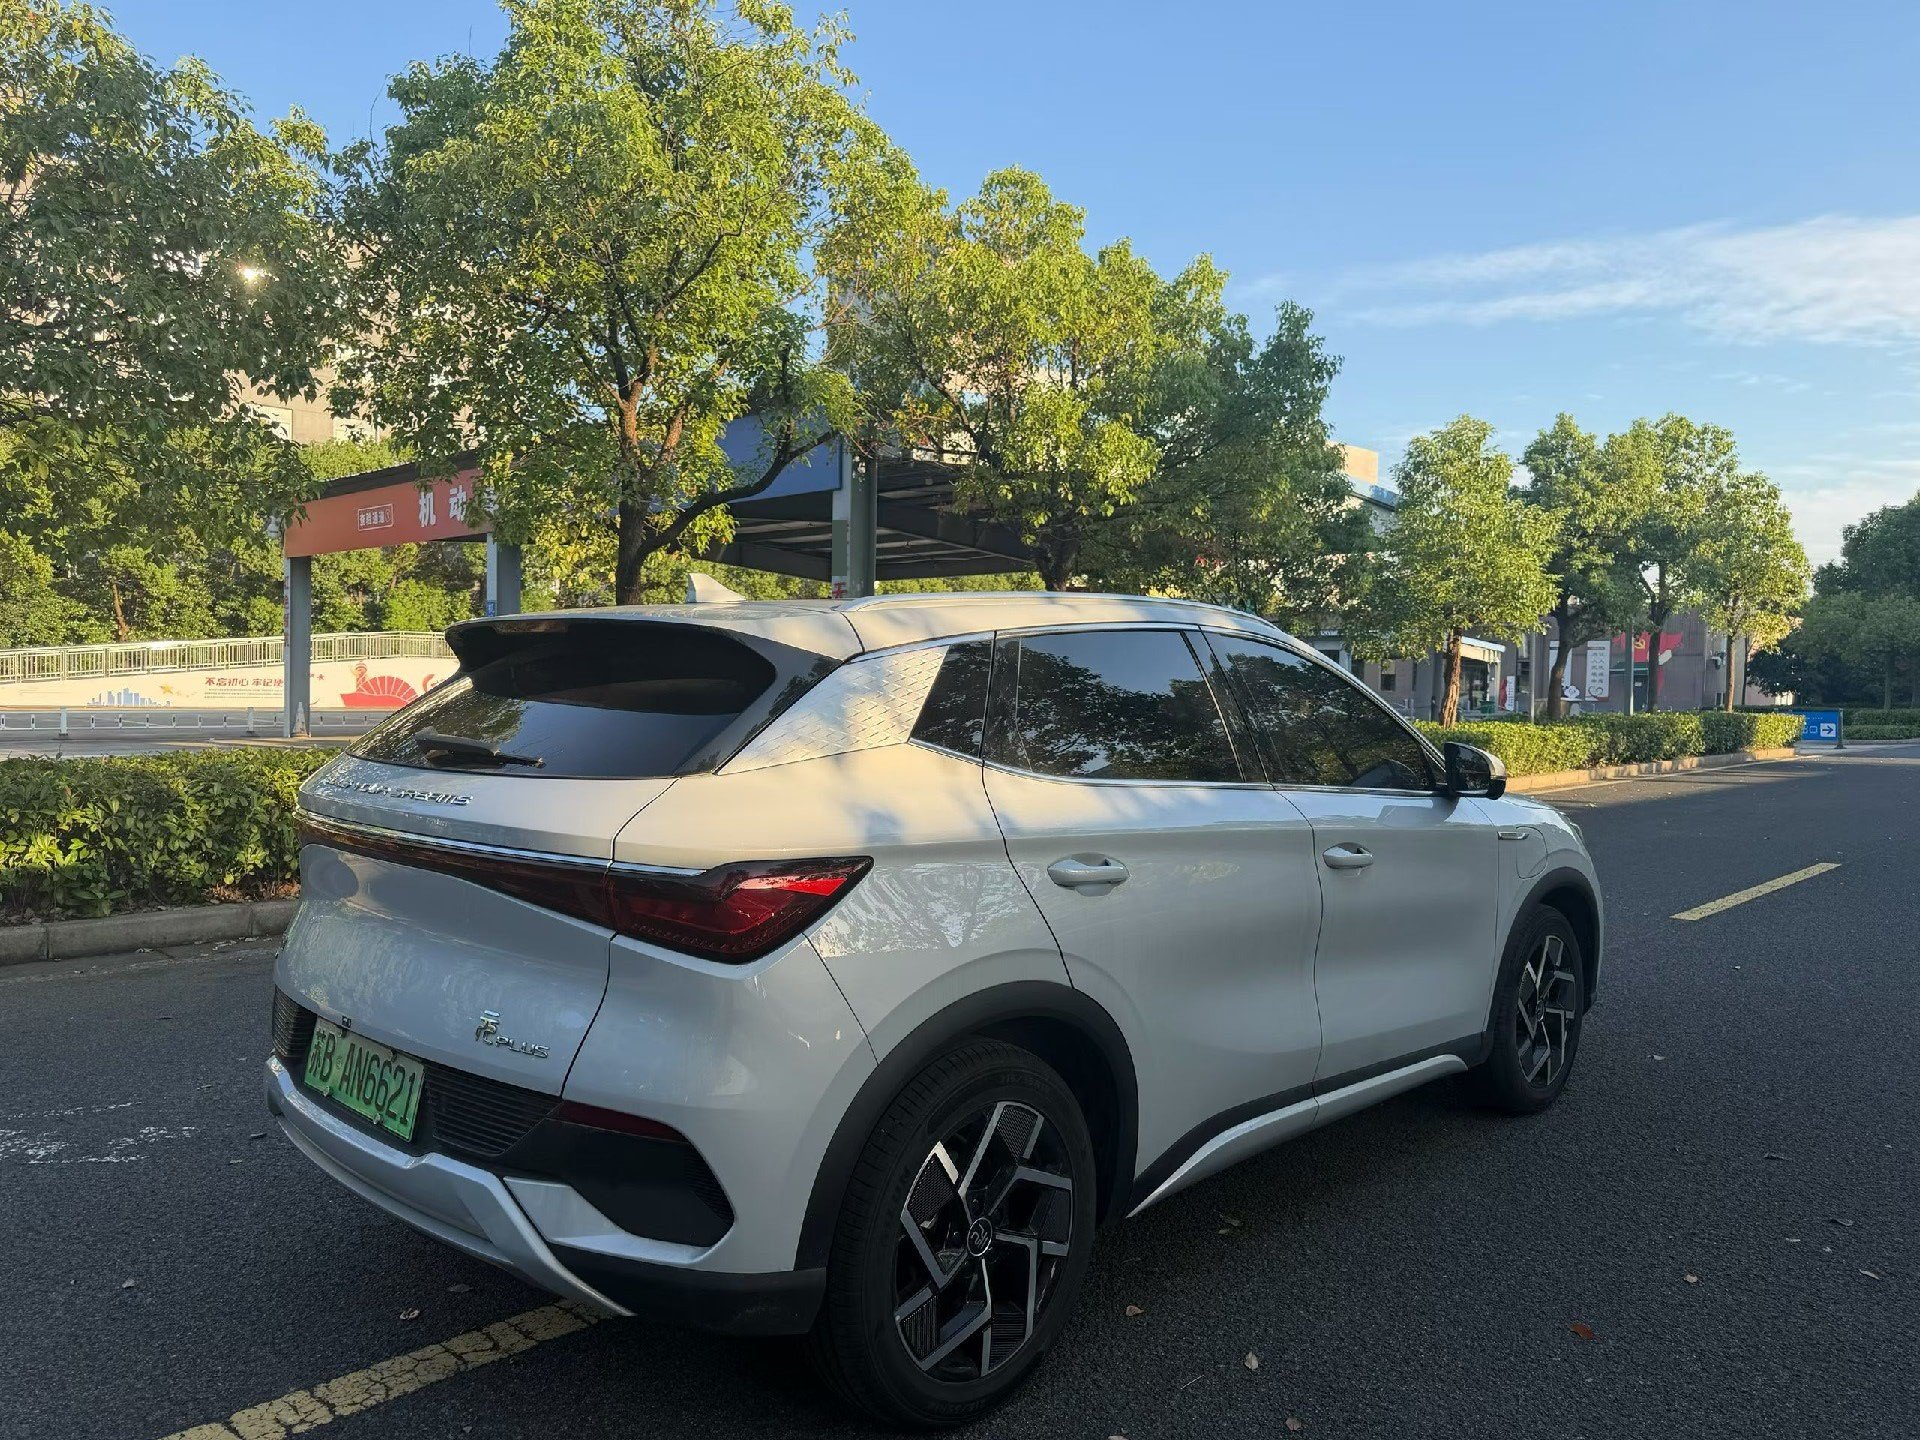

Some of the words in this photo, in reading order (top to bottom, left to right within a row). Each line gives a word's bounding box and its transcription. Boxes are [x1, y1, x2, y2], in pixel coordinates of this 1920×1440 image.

[205, 677, 249, 687] 不忘初心
[496, 1035, 550, 1058] PLUS
